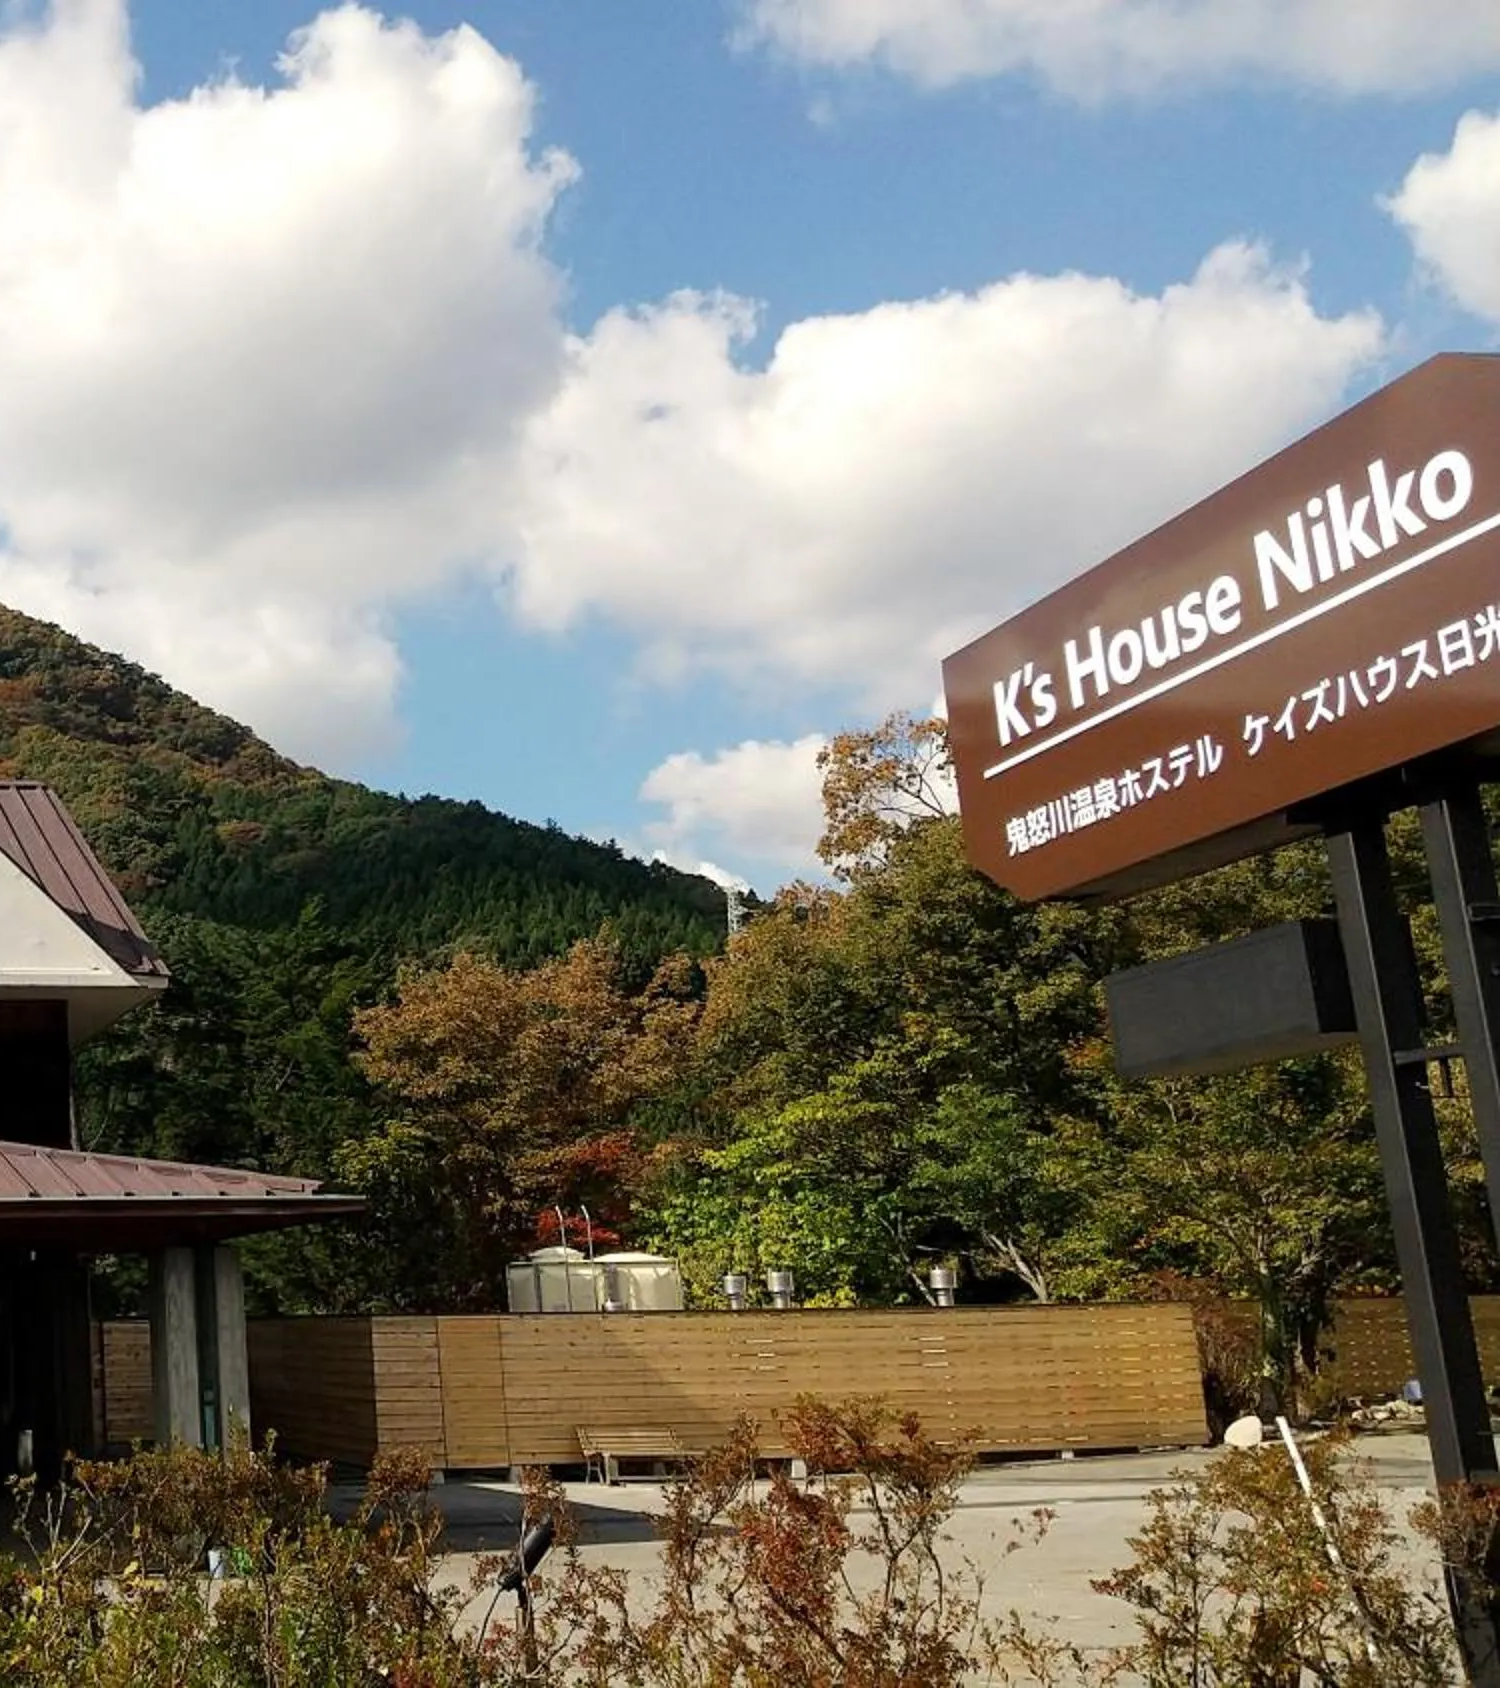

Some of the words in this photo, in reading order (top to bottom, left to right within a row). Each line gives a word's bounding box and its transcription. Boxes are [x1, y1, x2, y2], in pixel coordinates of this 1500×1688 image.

[993, 660, 1056, 747] K's
[1064, 575, 1241, 709] House
[1253, 450, 1473, 612] Nikko
[1005, 735, 1223, 857] 鬼怒川温泉ホステル
